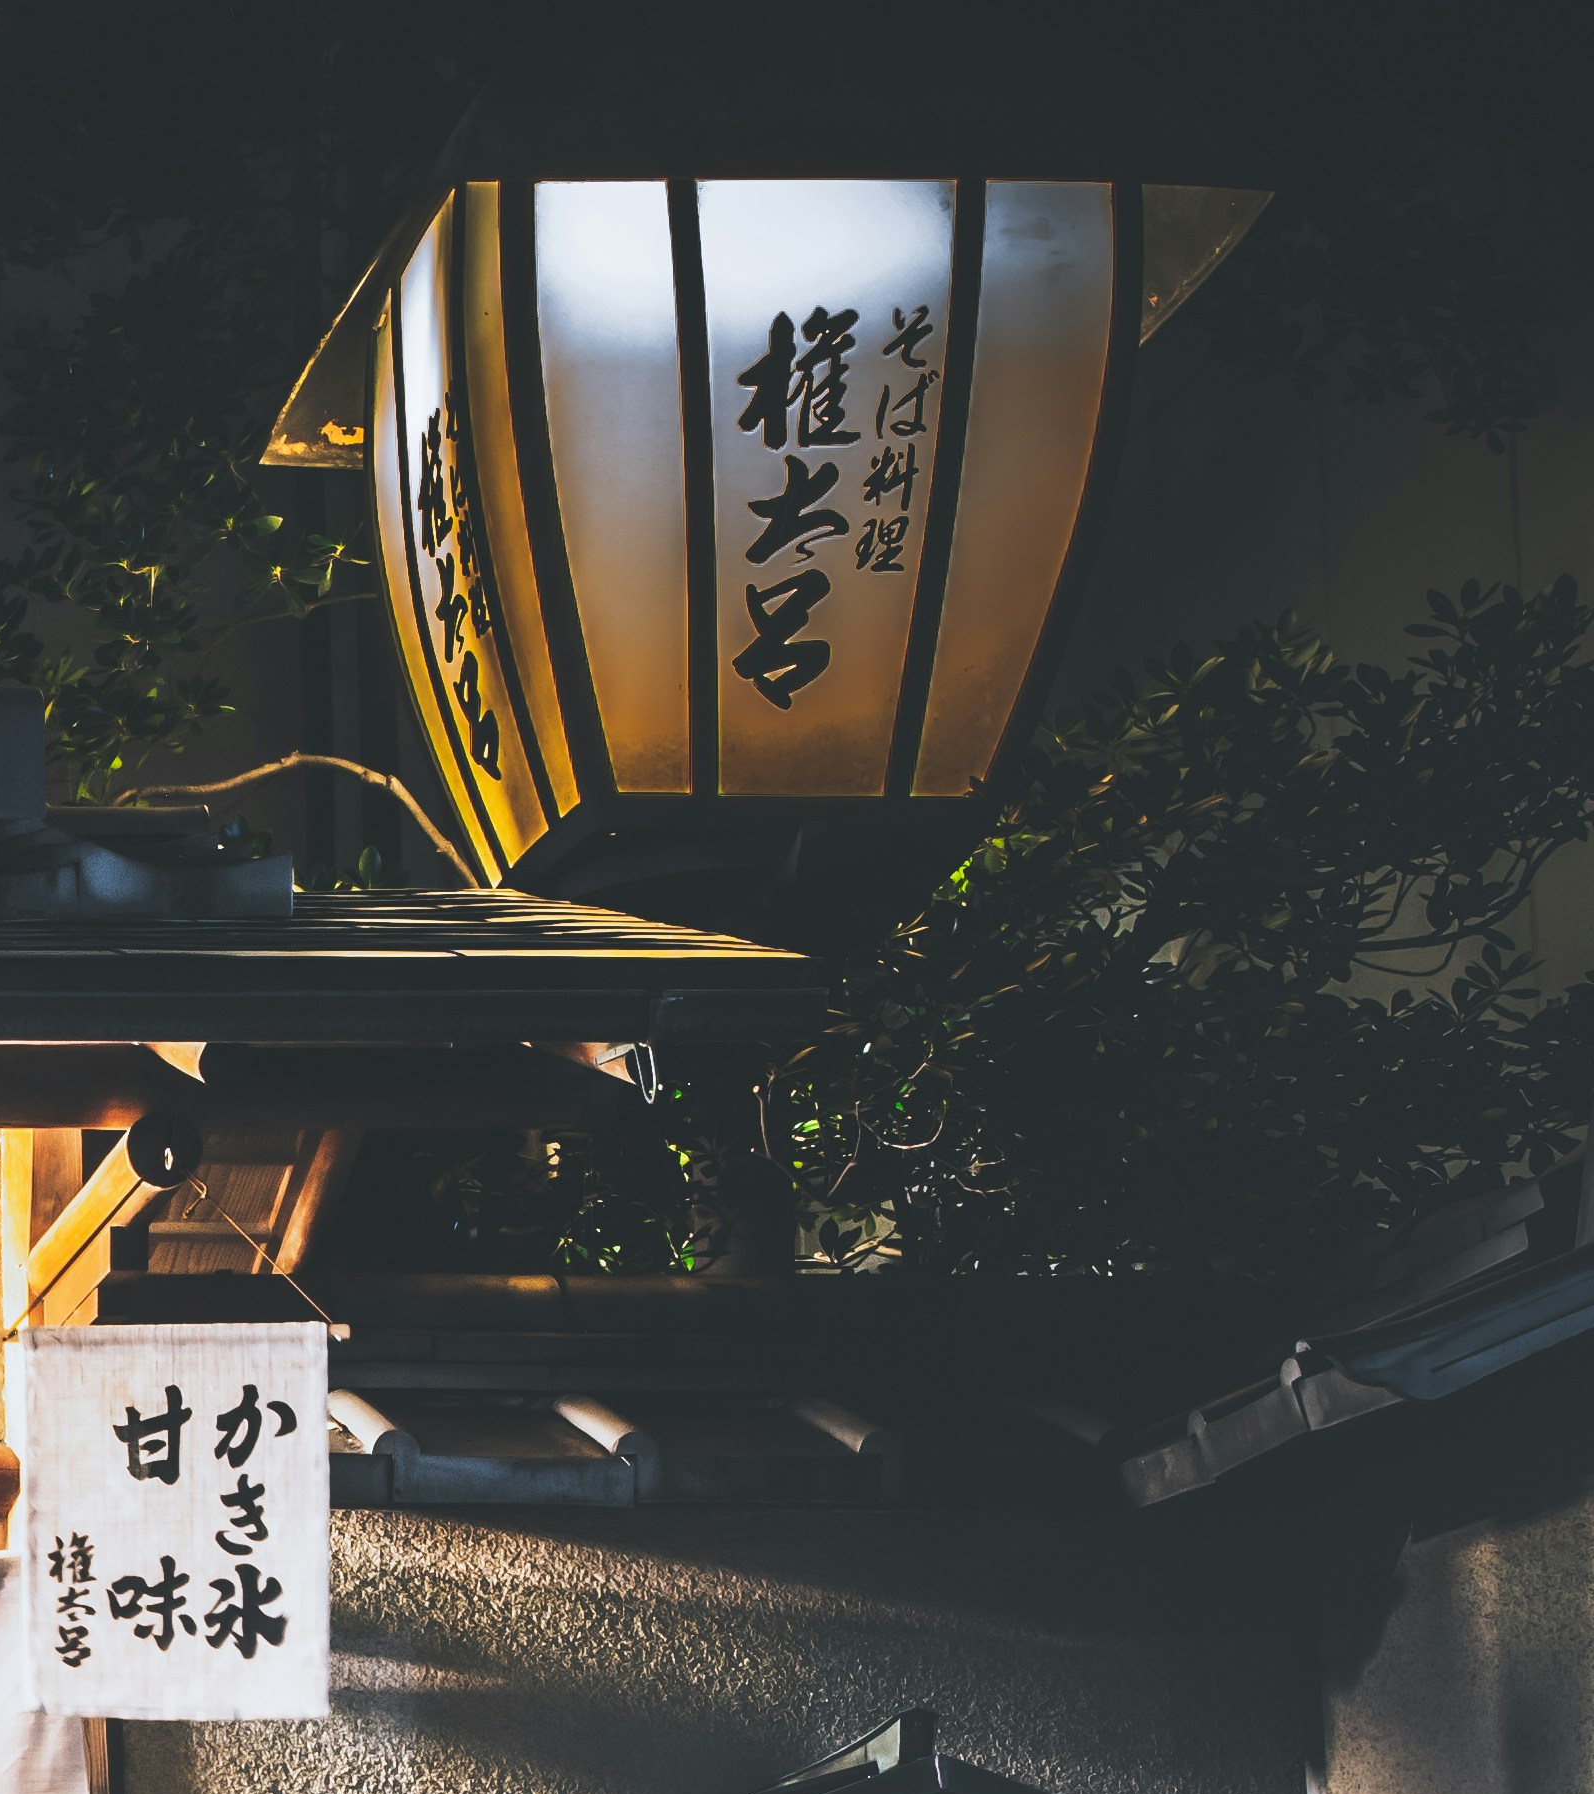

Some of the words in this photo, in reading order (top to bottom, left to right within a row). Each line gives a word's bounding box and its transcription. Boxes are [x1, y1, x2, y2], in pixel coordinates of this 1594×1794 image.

[854, 303, 939, 574] そば料理
[106, 1384, 198, 1652] 甘味
[205, 1384, 297, 1660] かき氷
